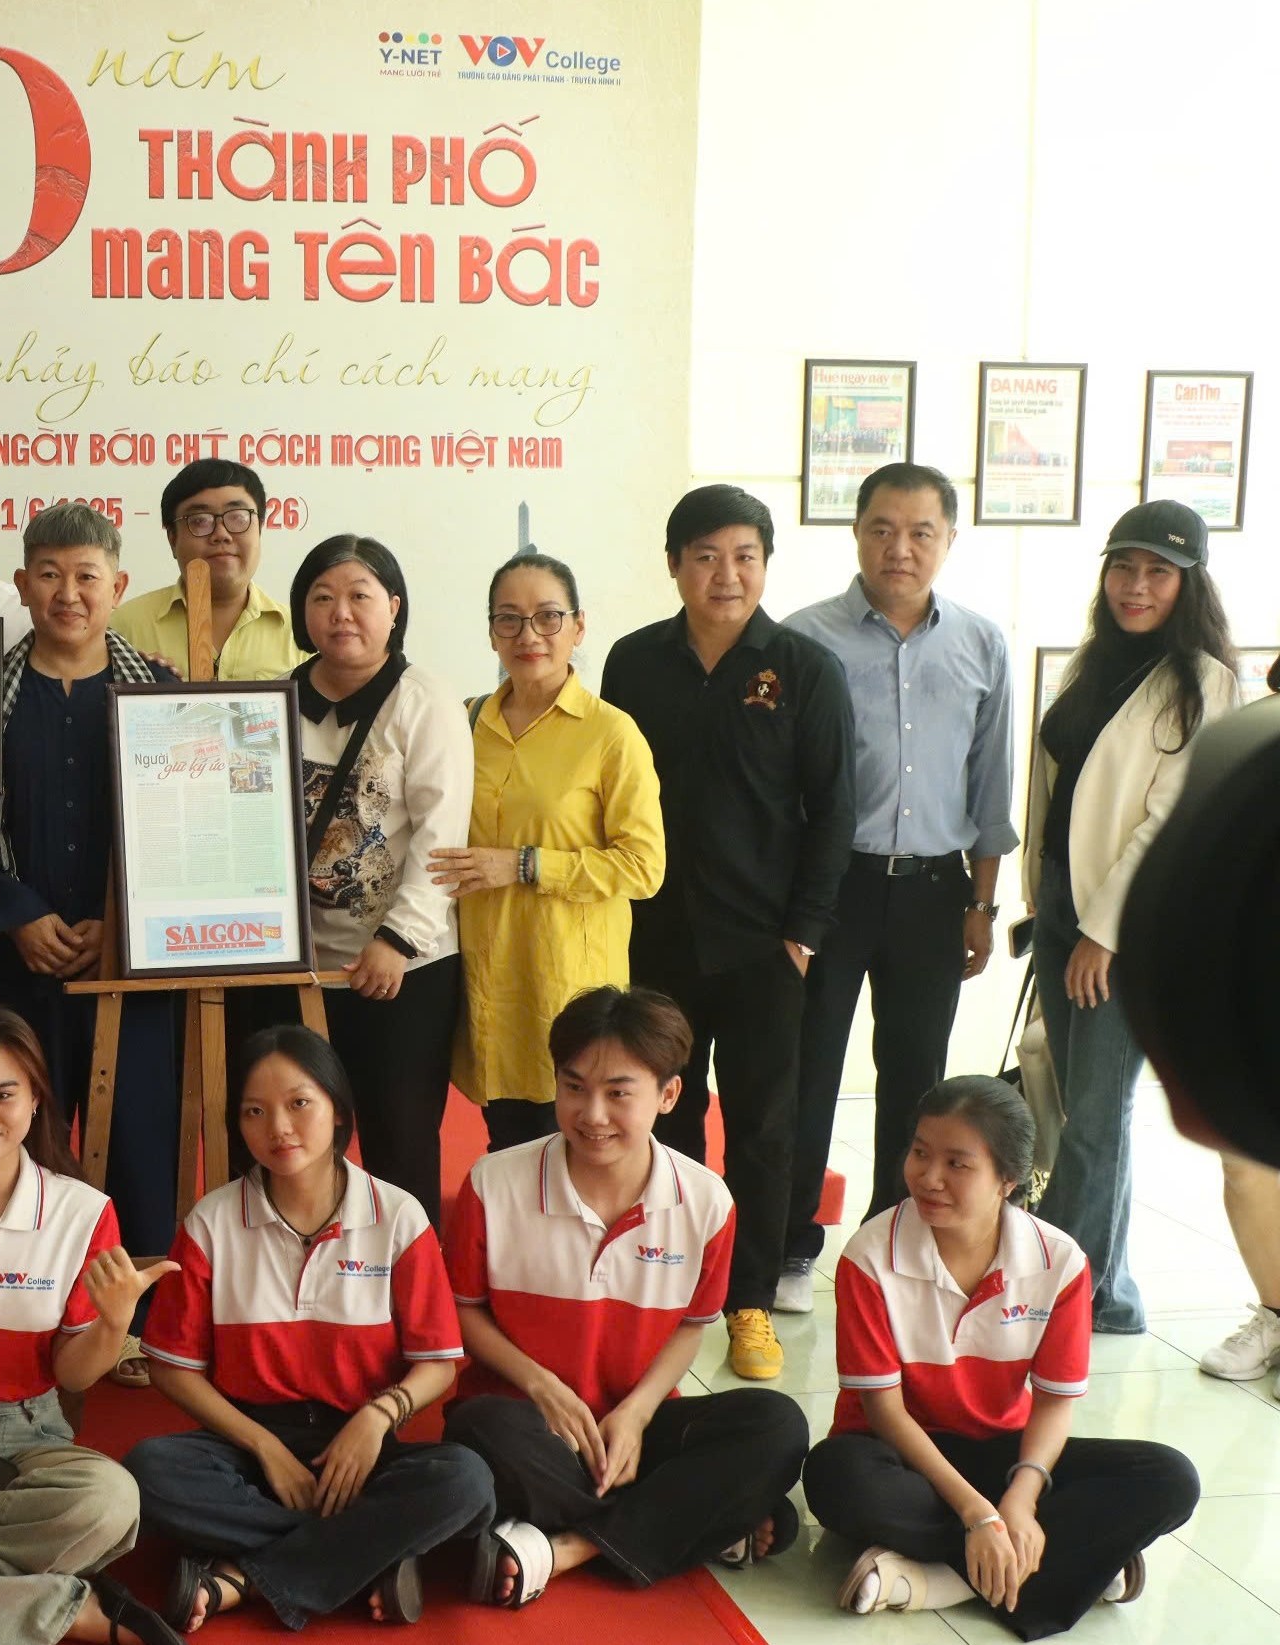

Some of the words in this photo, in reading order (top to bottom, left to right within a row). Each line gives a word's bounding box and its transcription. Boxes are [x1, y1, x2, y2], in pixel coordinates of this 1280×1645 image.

[87, 29, 286, 91] năm
[379, 48, 442, 66] Y-NET
[546, 50, 621, 75] College
[127, 331, 222, 387] báo
[240, 331, 321, 387] chí
[339, 333, 451, 387] cách
[467, 361, 598, 428] mạng
[134, 752, 169, 769] Người
[27, 1277, 55, 1287] College
